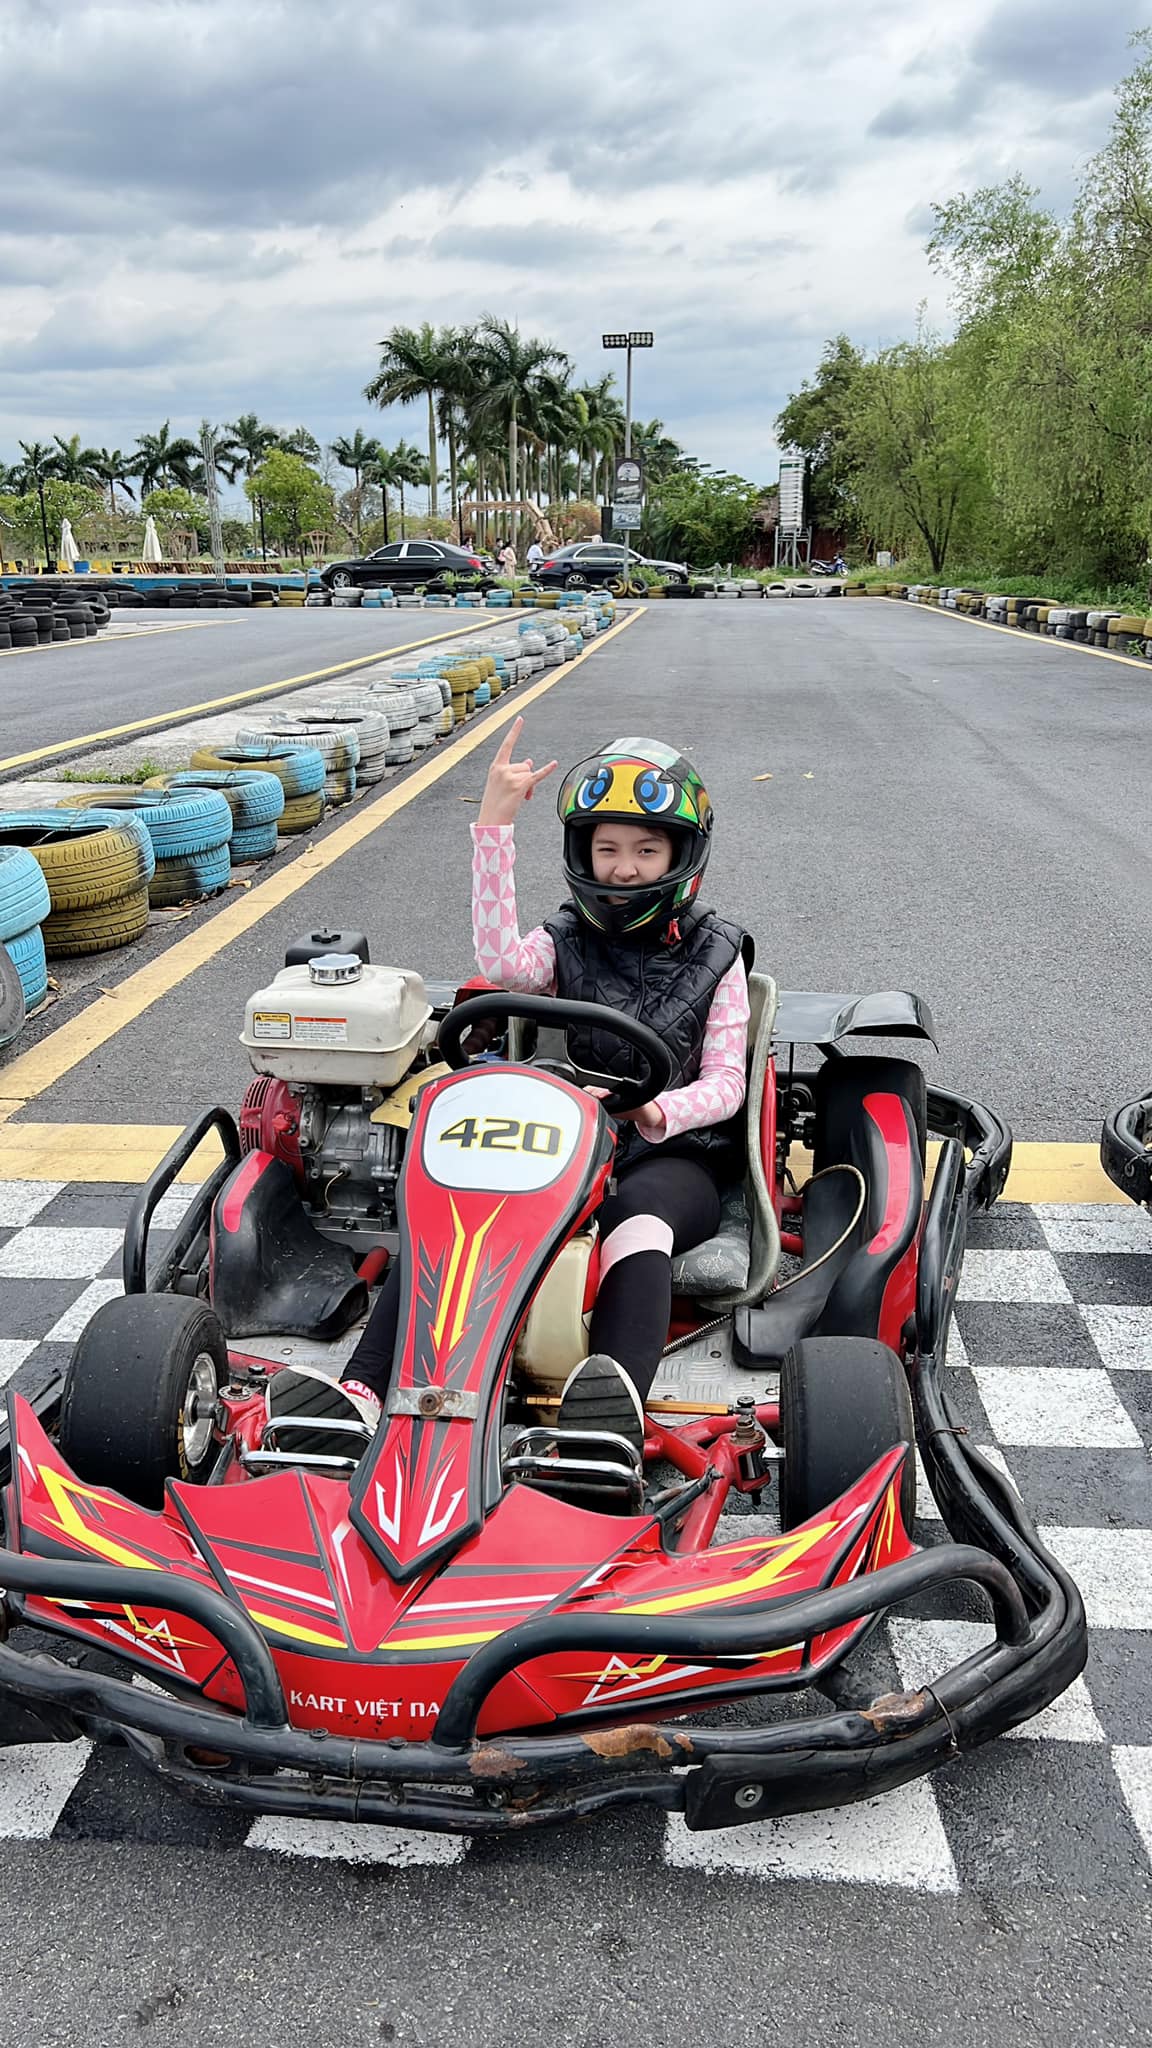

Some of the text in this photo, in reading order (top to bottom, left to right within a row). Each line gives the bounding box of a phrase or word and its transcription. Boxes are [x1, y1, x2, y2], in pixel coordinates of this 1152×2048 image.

[439, 1117, 562, 1157] 420
[290, 1690, 440, 1719] KART VIỆT NA
